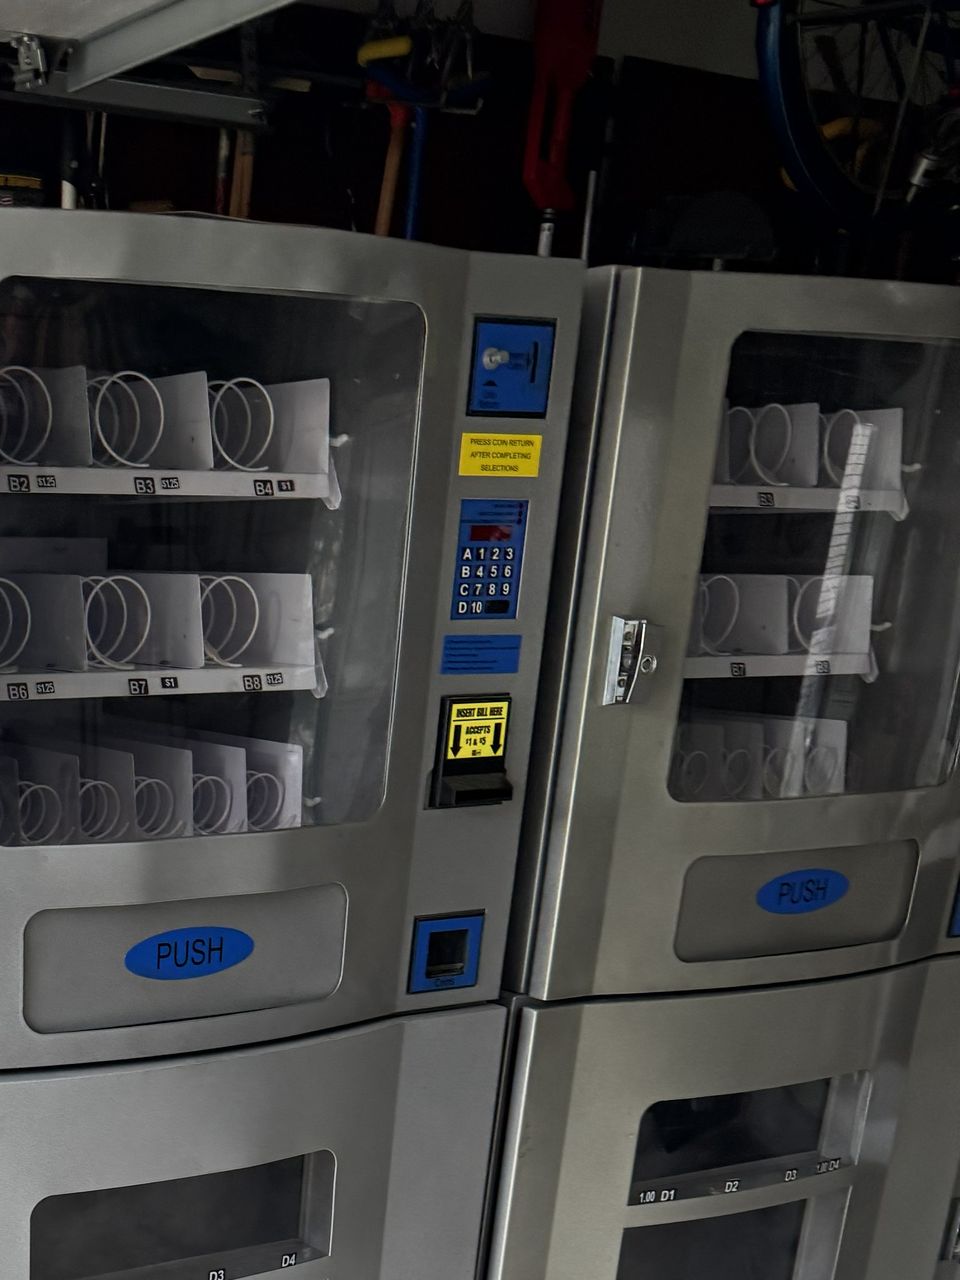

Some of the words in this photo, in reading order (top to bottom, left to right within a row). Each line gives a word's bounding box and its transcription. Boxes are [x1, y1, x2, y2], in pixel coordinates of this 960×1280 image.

[470, 438, 491, 446] PRESS
[492, 439, 508, 447] COIN
[508, 439, 534, 447] RETURN
[470, 450, 491, 459] AFTER
[491, 452, 532, 460] COMPLETING
[480, 464, 519, 472] SELECTIONS
[8, 476, 29, 492] B2
[135, 478, 154, 493] B3
[254, 481, 273, 496] B4
[462, 548, 472, 560] A
[479, 548, 485, 560] 1
[492, 548, 500, 560] 2
[505, 548, 513, 560] 3
[461, 565, 470, 578] B
[476, 565, 483, 578] 4
[490, 565, 497, 577] 5
[504, 565, 512, 577] 6
[460, 583, 469, 596] C
[475, 583, 482, 596] 7
[488, 583, 496, 595] 8
[502, 583, 510, 595] 9
[458, 601, 467, 614] D
[471, 601, 483, 614] 10
[129, 680, 147, 694] B7
[244, 676, 261, 690] B8
[8, 685, 28, 699] B6
[456, 708, 476, 718] INSERT
[476, 707, 488, 717] BILL
[489, 706, 504, 716] HERE
[465, 725, 491, 735] ACCEPTS
[778, 877, 830, 906] PUSH
[156, 936, 224, 970] PUSH
[784, 1169, 797, 1182] D3
[724, 1180, 739, 1193] D2
[639, 1190, 656, 1203] 1.00
[660, 1189, 675, 1202] D1
[281, 1253, 296, 1267] D4
